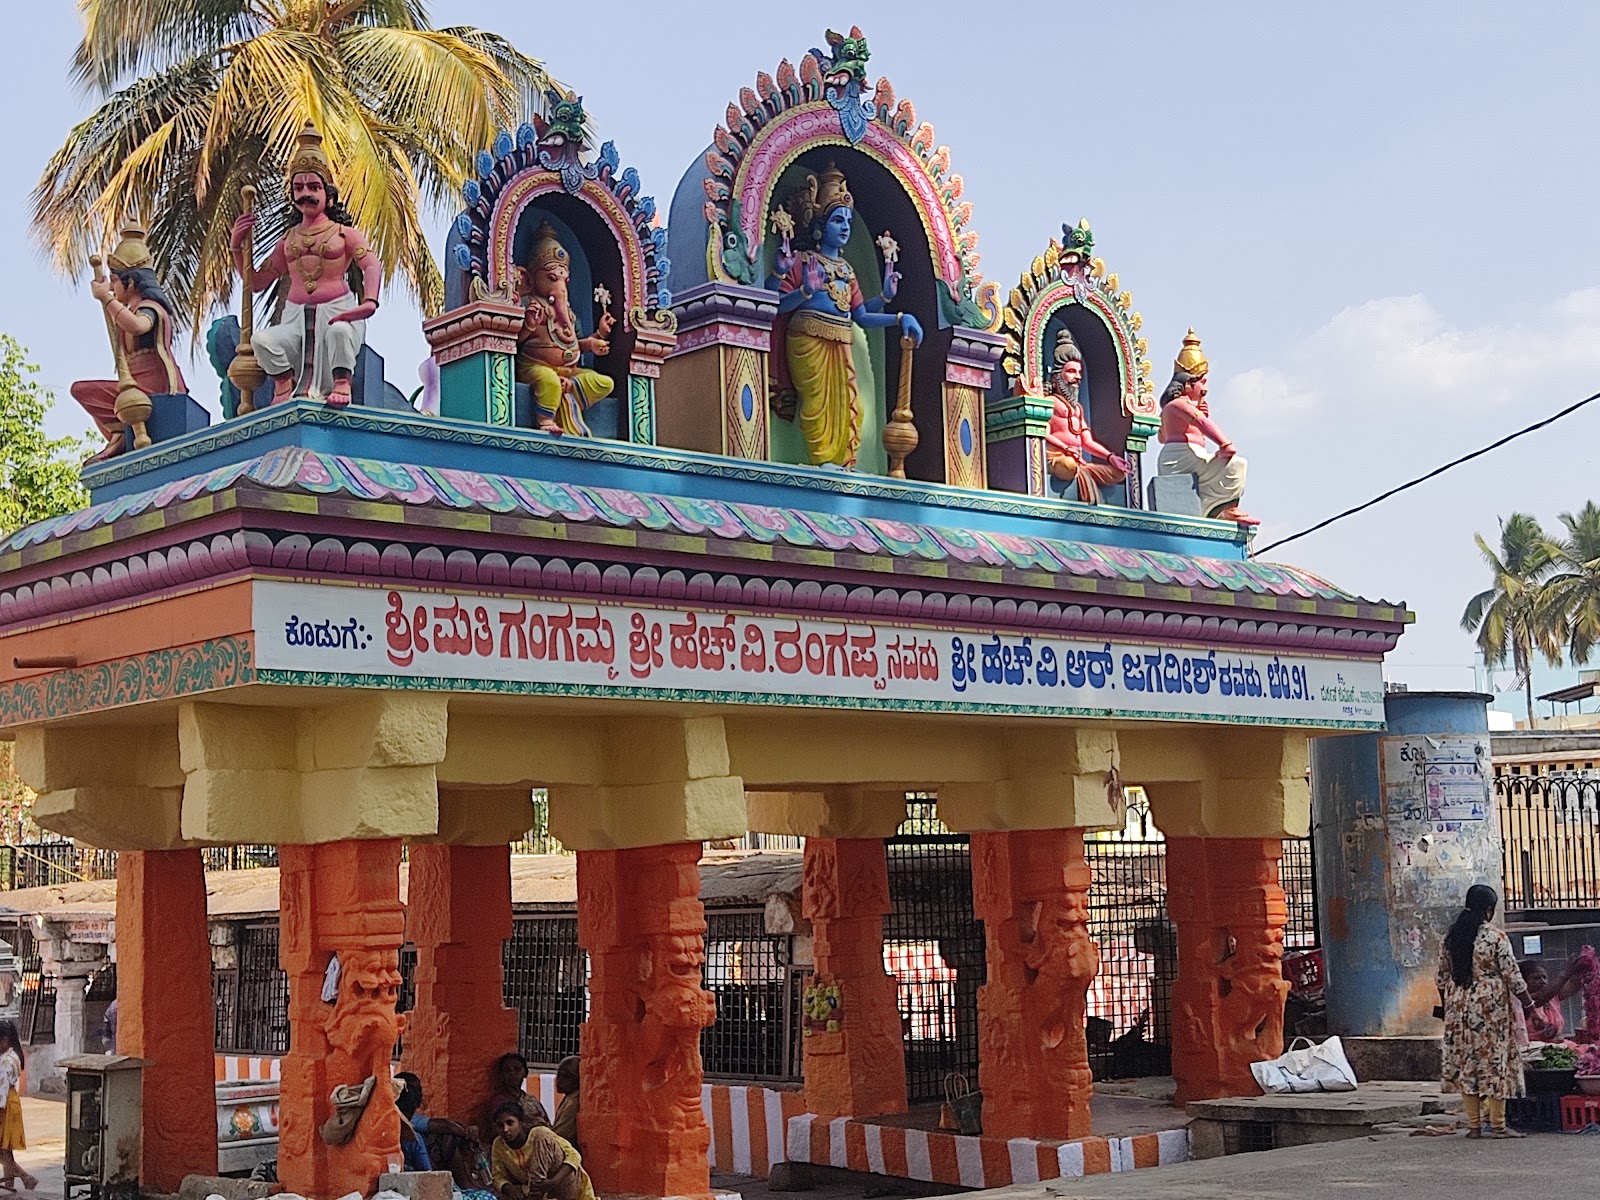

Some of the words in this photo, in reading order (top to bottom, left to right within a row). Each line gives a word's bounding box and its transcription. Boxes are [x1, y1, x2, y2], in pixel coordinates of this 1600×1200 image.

[385, 590, 494, 667] ಶ್ರೀಮತಿ
[499, 601, 619, 681] ಗಂಗಮ್ಮ
[629, 612, 664, 679] ಶ್ರೀ
[951, 636, 977, 693] ಶ್ರೀ
